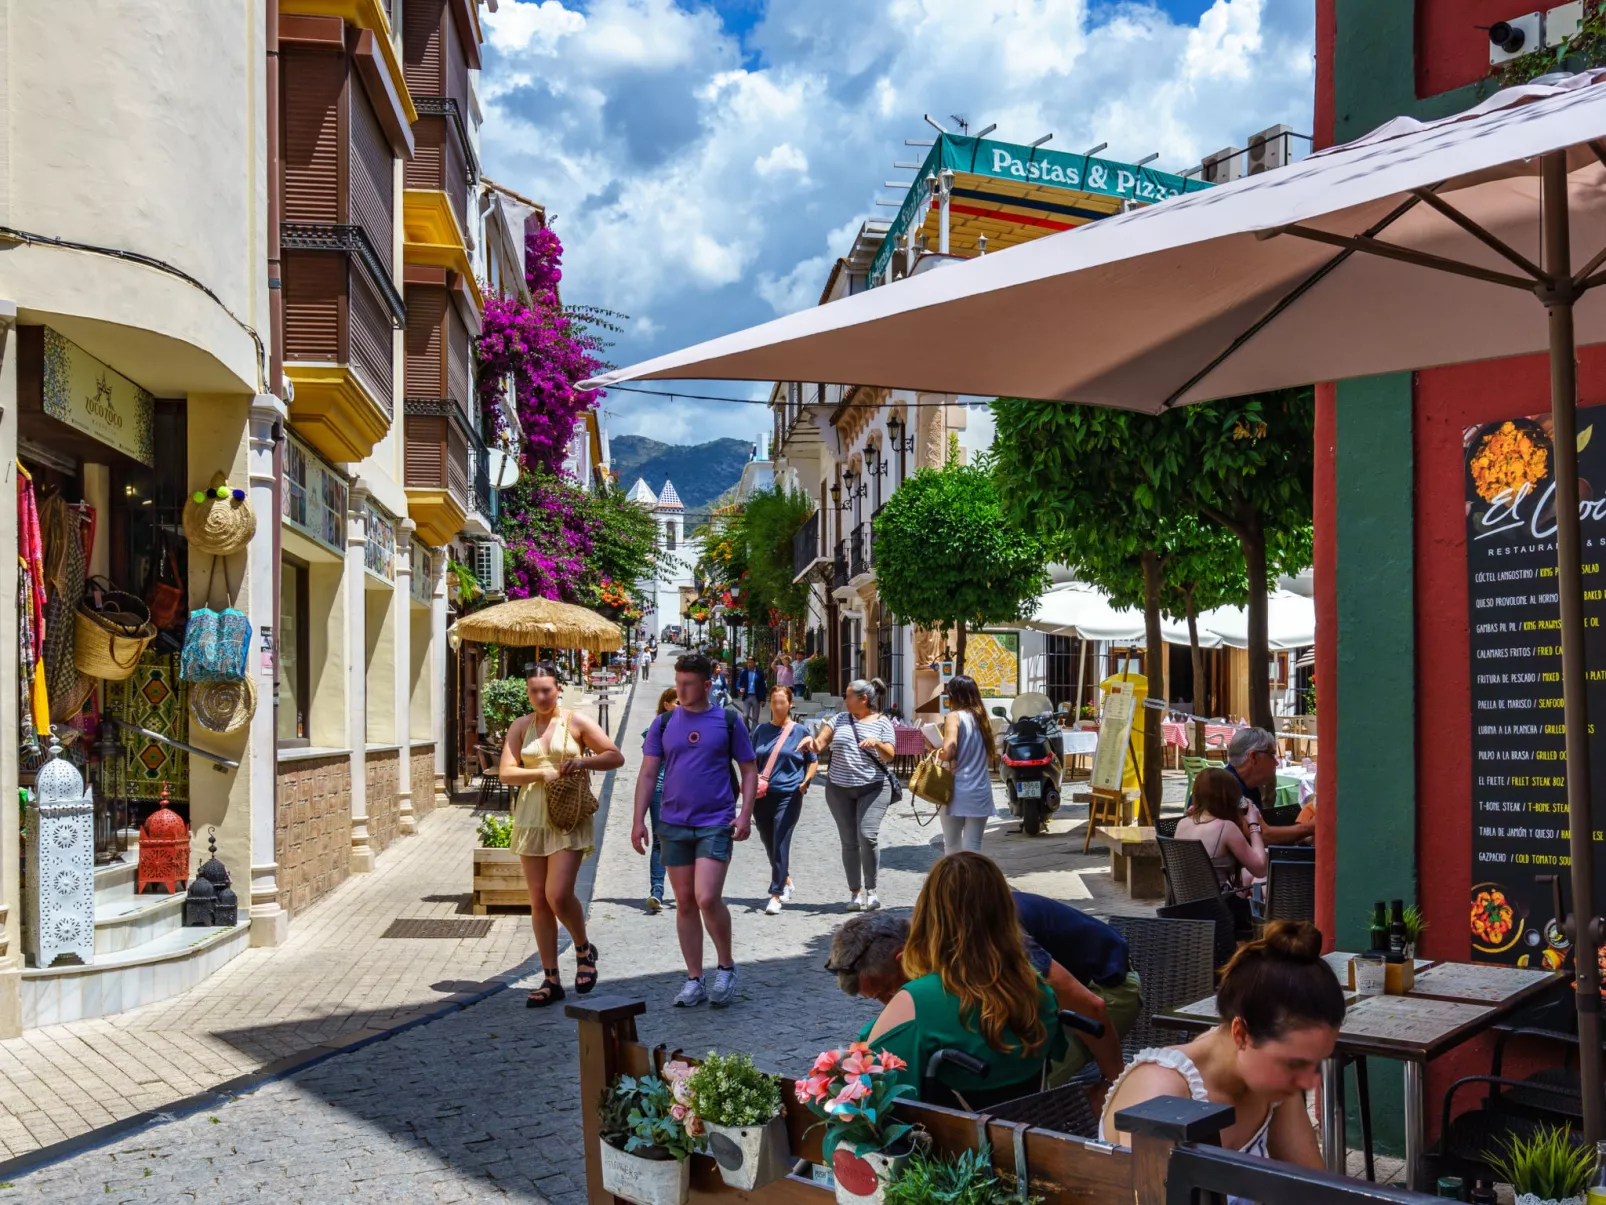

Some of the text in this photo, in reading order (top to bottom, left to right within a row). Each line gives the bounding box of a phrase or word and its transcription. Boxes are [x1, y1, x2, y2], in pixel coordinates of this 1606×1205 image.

[991, 148, 1079, 185] Pastas
[1087, 165, 1108, 190] &
[1481, 481, 1531, 526] El
[1586, 539, 1593, 547] &
[1475, 571, 1496, 583] CÓCTEL
[1498, 569, 1533, 581] LANGOSTINO
[1540, 567, 1553, 577] KING
[1581, 563, 1600, 574] SALAD
[1475, 598, 1494, 608] QUESO
[1495, 596, 1527, 607] PROVOLONE
[1529, 595, 1536, 604] AL
[1538, 593, 1559, 604] HORNO
[1583, 590, 1602, 600] BAKED
[1476, 623, 1498, 633] GAMBAS
[1509, 622, 1517, 631] PIL
[1523, 621, 1536, 630] KING
[1538, 619, 1562, 630] PRAWNS
[1590, 617, 1600, 627] OIL
[1476, 648, 1508, 658] CALAMARES
[1510, 647, 1531, 657] FRITOS
[1537, 646, 1553, 656] FRIED
[1477, 674, 1500, 684] FRITURA
[1502, 673, 1509, 683] DE
[1511, 673, 1535, 683] PESCADO
[1542, 672, 1560, 682] MIXED
[1478, 700, 1497, 709] PAELLA
[1498, 700, 1505, 709] DE
[1507, 699, 1532, 709] MARISCO
[1538, 699, 1565, 709] SEAFOOD
[1478, 725, 1497, 735] LUBINA
[1498, 725, 1502, 734] A
[1504, 725, 1512, 734] LA
[1513, 724, 1538, 734] PLANCHA
[1544, 724, 1567, 734] GRILLED
[1478, 751, 1495, 760] PULPO
[1496, 751, 1500, 760] A
[1502, 751, 1510, 760] LA
[1511, 751, 1529, 760] BRASA
[1536, 751, 1557, 760] GRILLED
[1478, 776, 1485, 786] EL
[1486, 776, 1505, 786] FILETE
[1511, 776, 1529, 786] FILLET
[1531, 777, 1551, 786] STEAK
[1479, 801, 1500, 811] T-BONE
[1502, 802, 1520, 812] STEAK
[1527, 802, 1550, 812] T-BONE
[1479, 826, 1496, 836] TABLA
[1498, 827, 1505, 836] DE
[1506, 826, 1527, 838] JAMÓN
[1529, 829, 1533, 838] Y
[1534, 829, 1554, 838] QUESO
[1478, 852, 1507, 862] GAZPACHO
[1515, 853, 1529, 864] COLD
[1531, 854, 1557, 865] TOMATO
